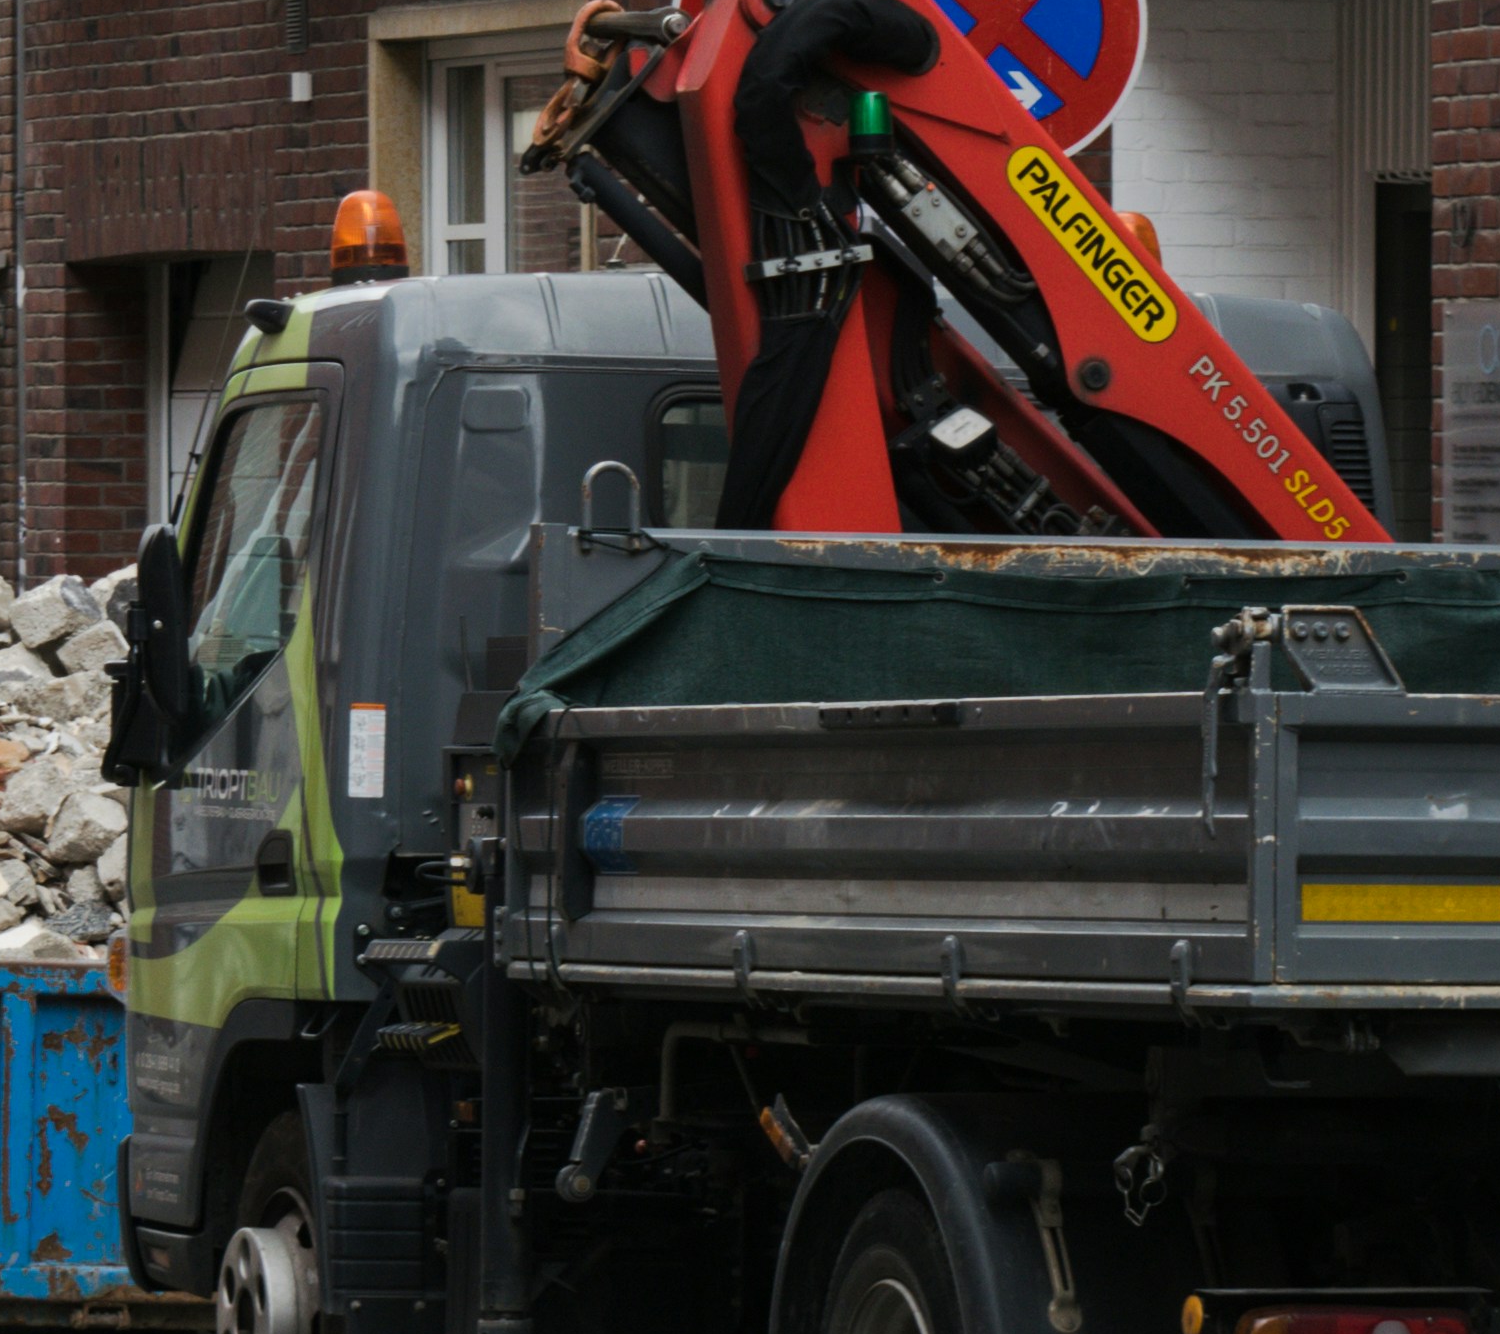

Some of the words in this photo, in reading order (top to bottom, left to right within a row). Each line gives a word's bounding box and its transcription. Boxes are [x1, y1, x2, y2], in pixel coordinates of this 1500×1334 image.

[1016, 157, 1167, 332] PALFINGER
[1189, 354, 1231, 402] PK
[1223, 395, 1292, 474] 5.501
[1284, 469, 1352, 540] SLD5
